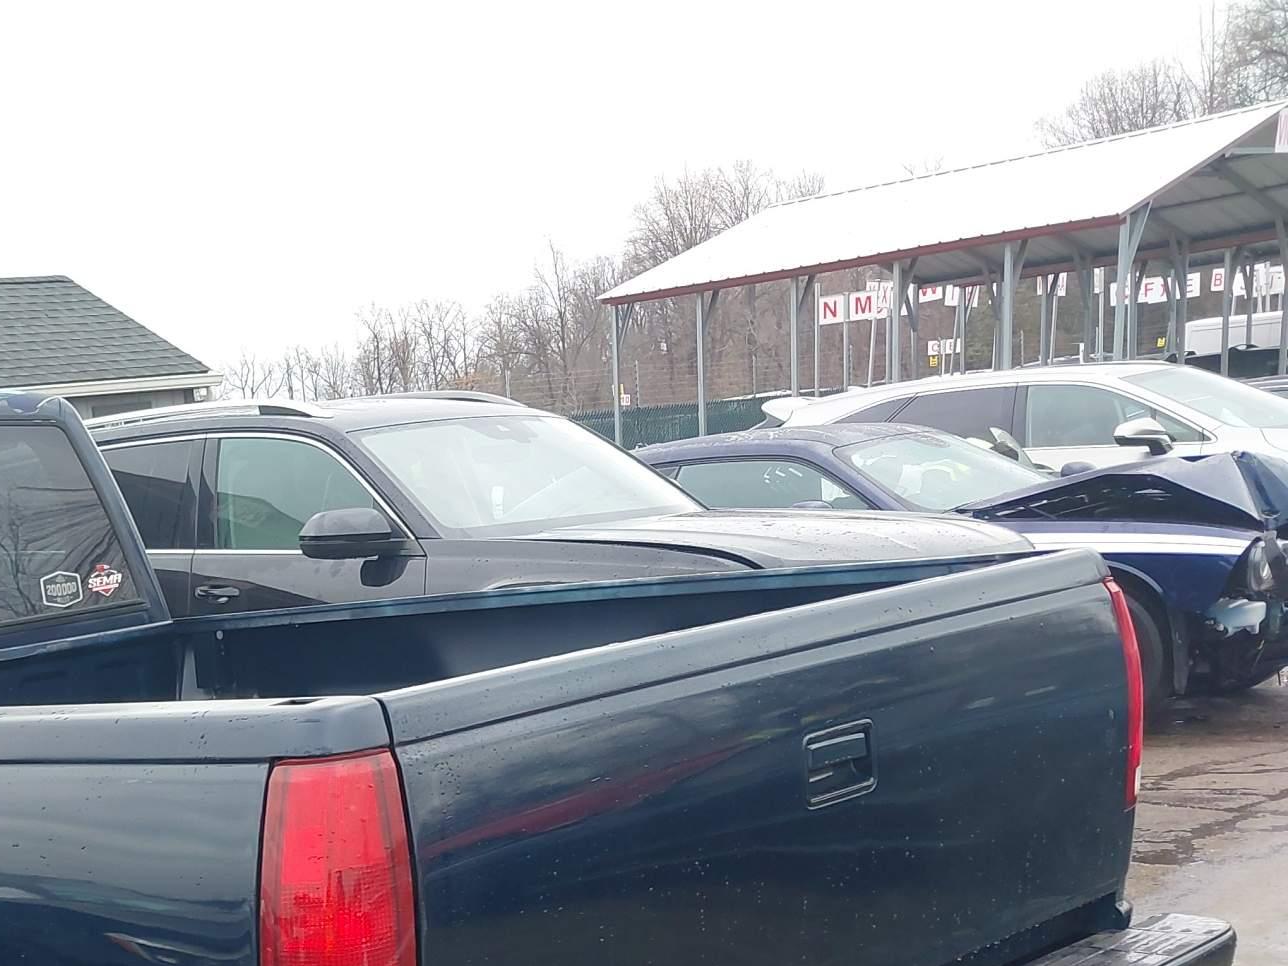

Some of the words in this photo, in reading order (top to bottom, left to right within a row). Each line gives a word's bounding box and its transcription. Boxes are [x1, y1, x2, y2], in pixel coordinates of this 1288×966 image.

[1213, 273, 1223, 287] B
[823, 300, 837, 319] N
[855, 295, 872, 315] M
[88, 573, 123, 588] SEMA
